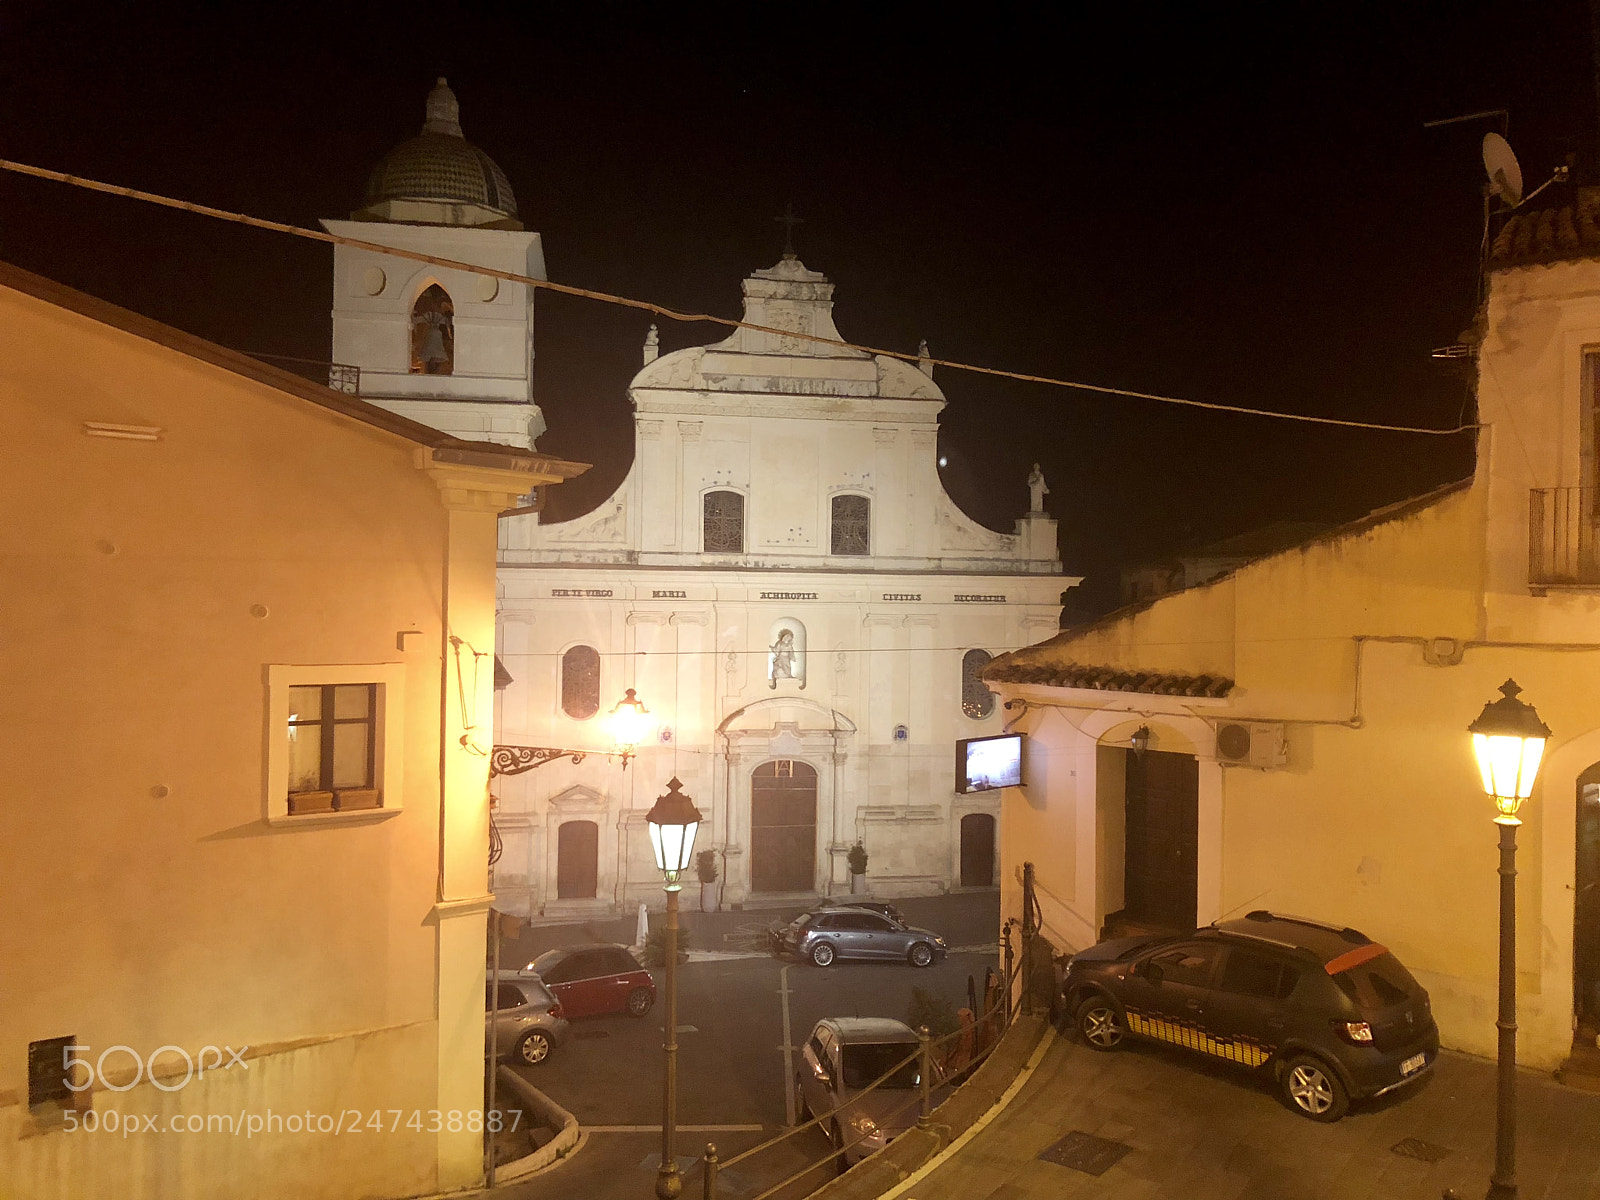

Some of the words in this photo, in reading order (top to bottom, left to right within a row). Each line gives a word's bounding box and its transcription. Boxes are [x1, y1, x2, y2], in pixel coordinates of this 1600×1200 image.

[586, 589, 613, 597] VIRGO
[653, 590, 687, 598] MARIA
[760, 592, 819, 600] ACHIROPITA
